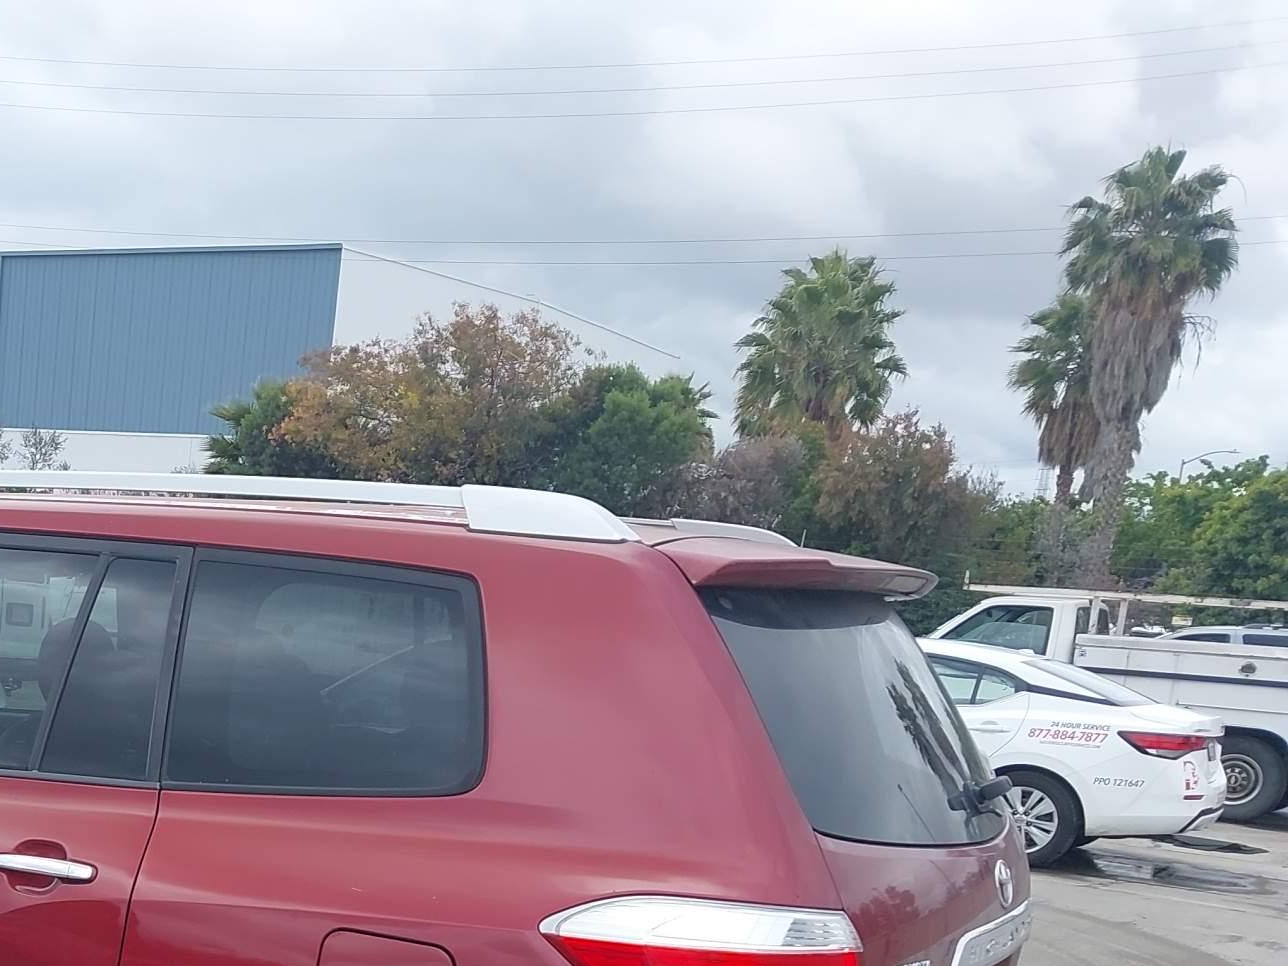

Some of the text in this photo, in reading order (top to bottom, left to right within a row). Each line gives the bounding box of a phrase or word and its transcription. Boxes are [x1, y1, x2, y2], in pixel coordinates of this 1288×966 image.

[1083, 723, 1112, 731] SERVICE
[1028, 727, 1109, 743] 877-884-7877
[1093, 777, 1145, 788] PPO 121647
